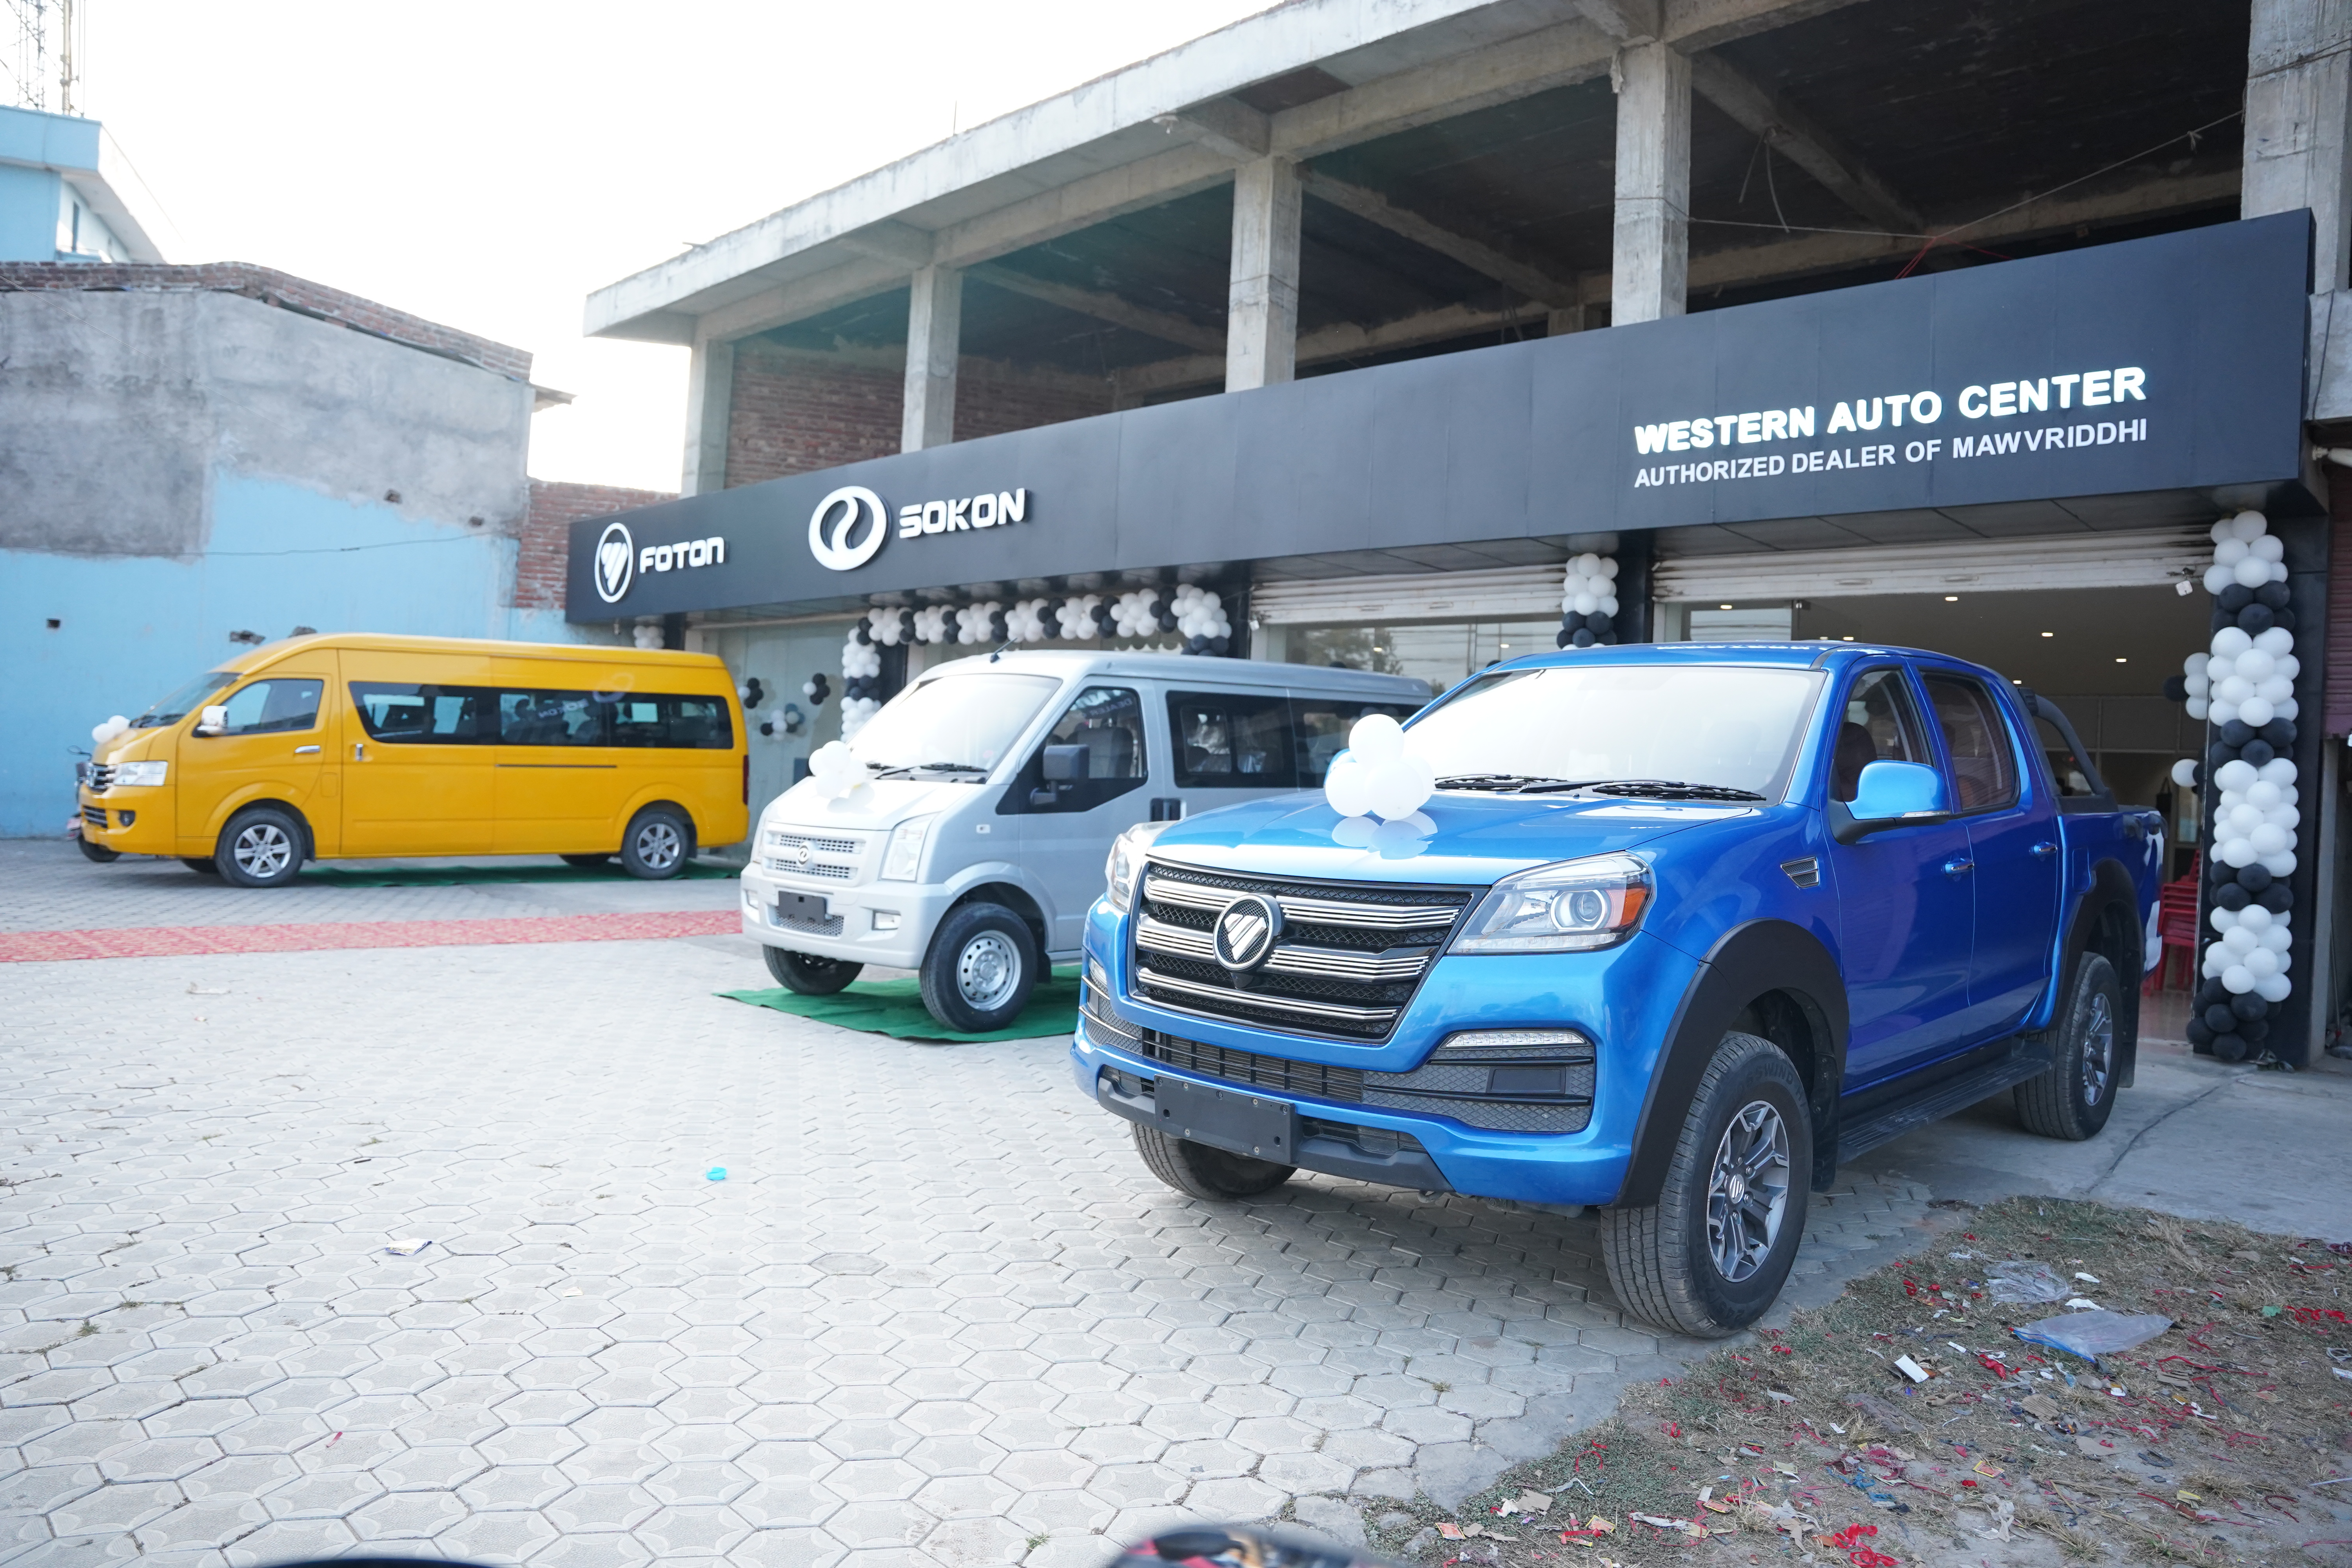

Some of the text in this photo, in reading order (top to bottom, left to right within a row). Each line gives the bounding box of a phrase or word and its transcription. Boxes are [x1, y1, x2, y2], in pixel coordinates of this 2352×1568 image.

[1634, 367, 2146, 455] WESTERN AUTO CENTER
[1634, 418, 2147, 488] AUTHORIZED DEALER OF MAWVRIDDHI
[899, 487, 1025, 539] SOKON
[639, 536, 724, 573] FOTON
